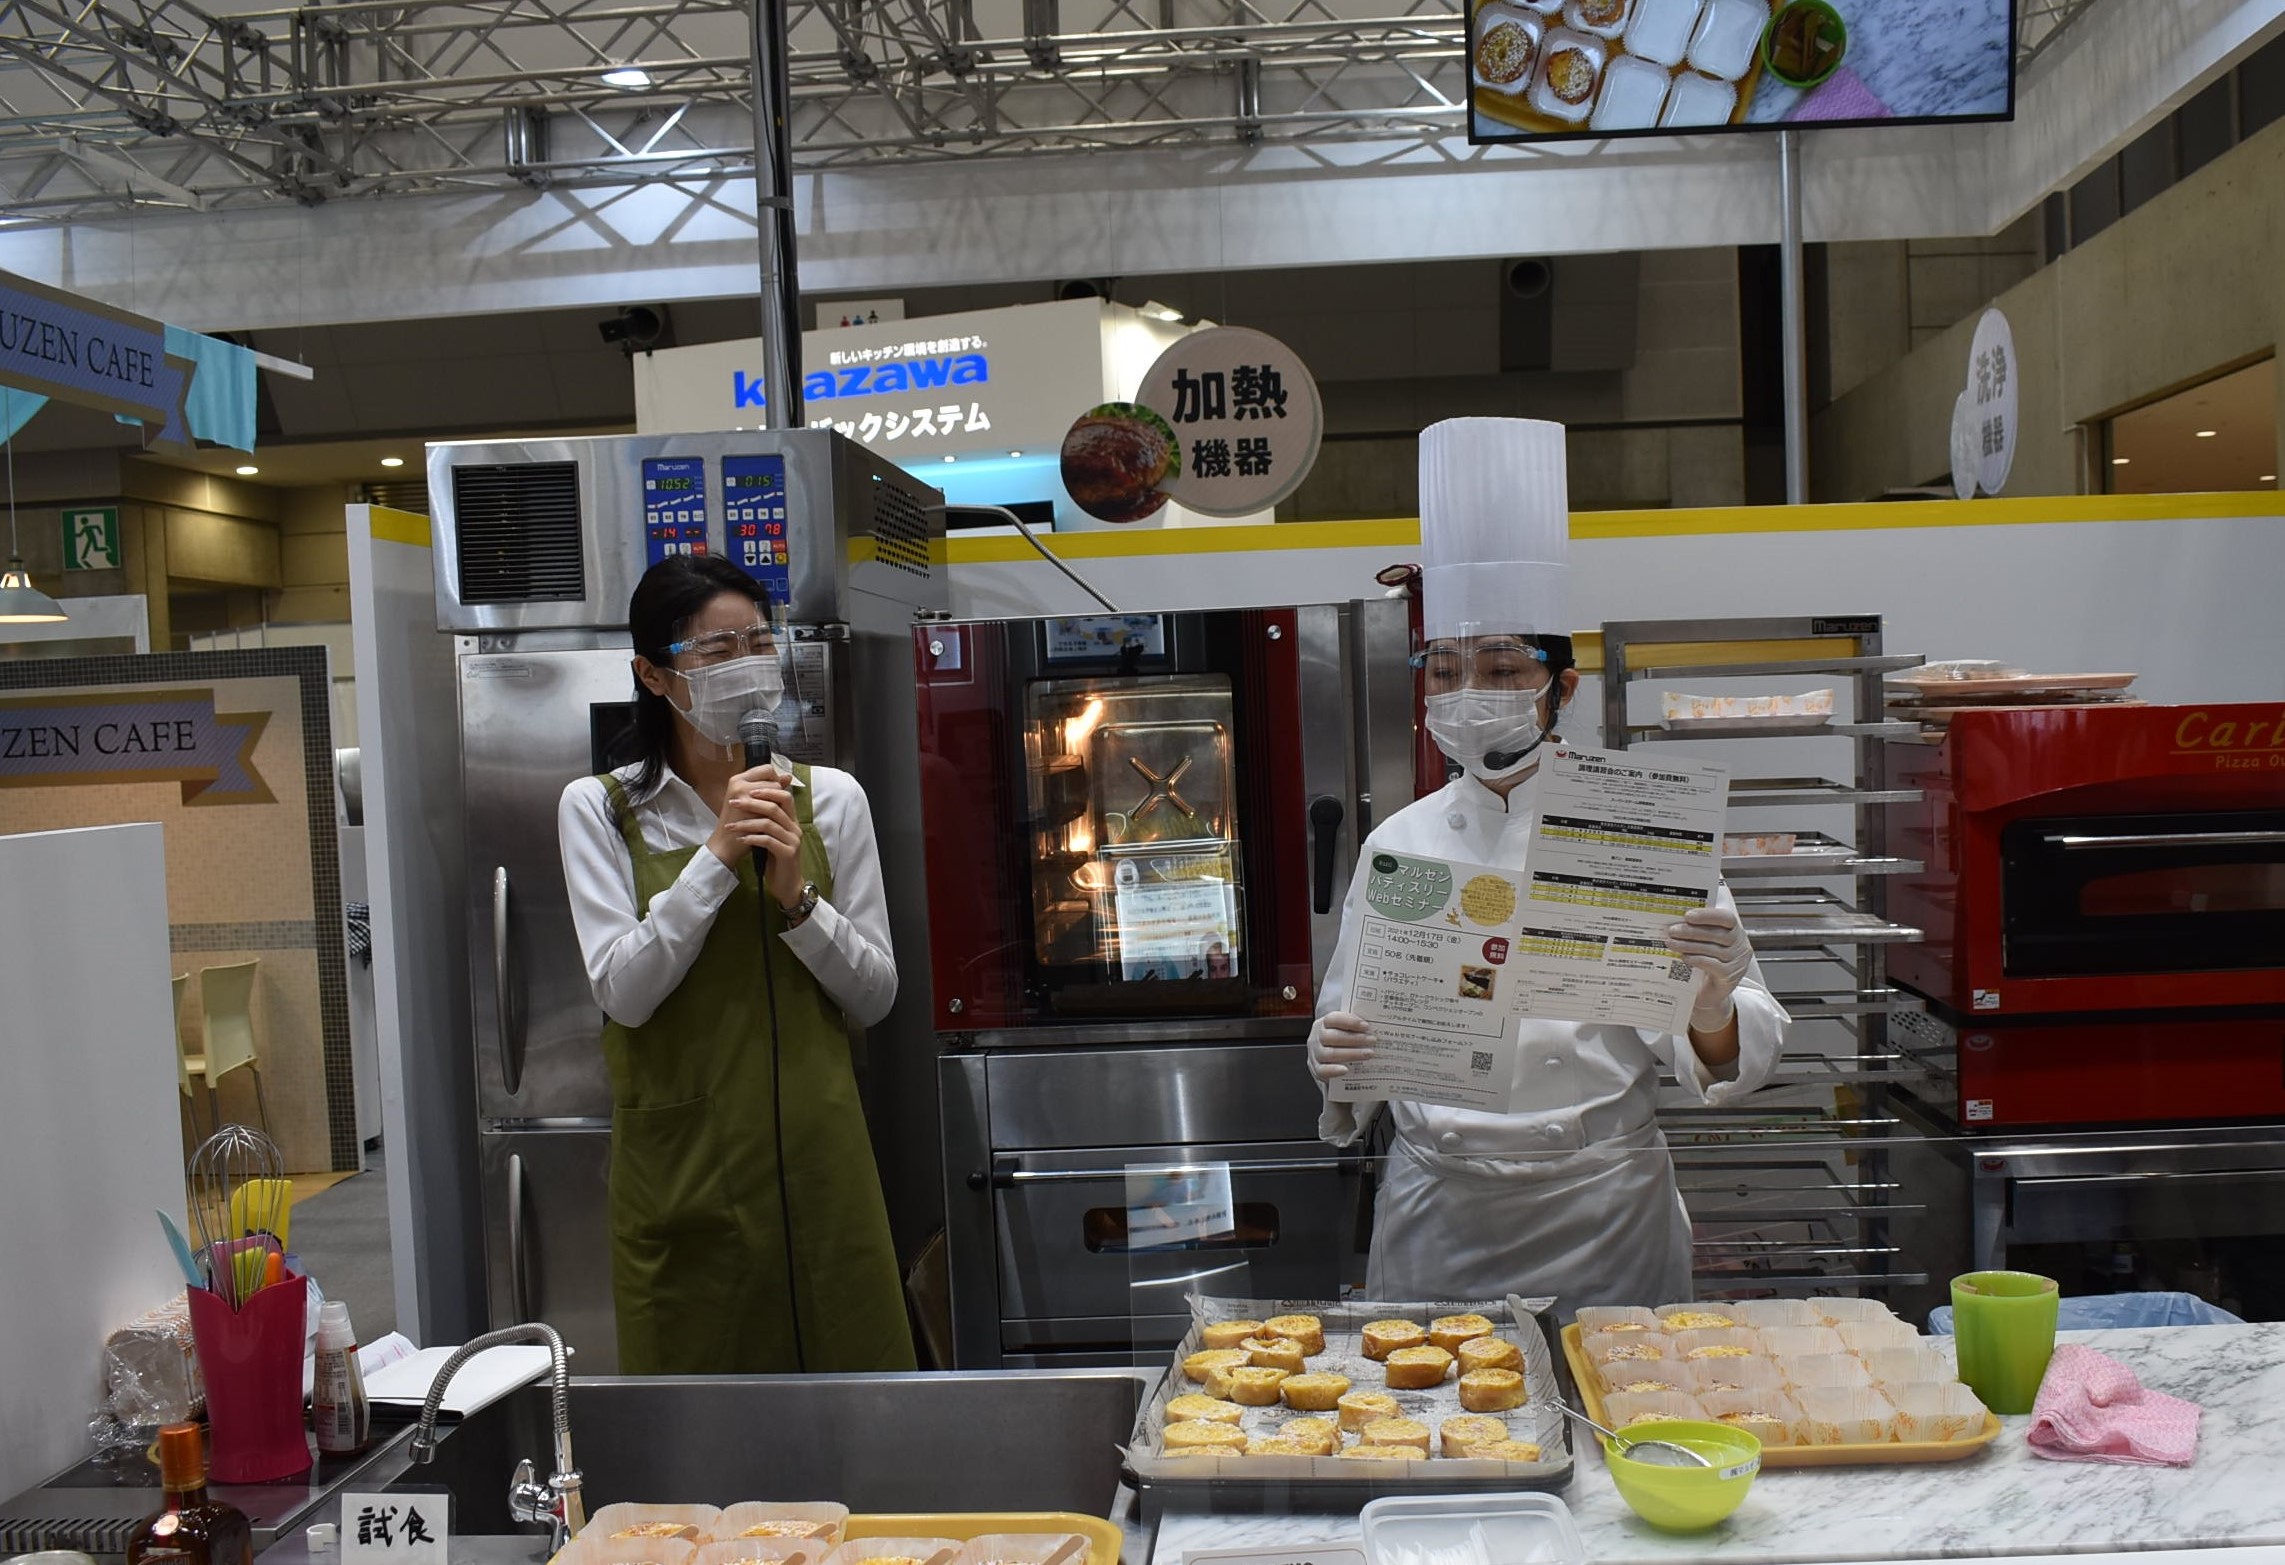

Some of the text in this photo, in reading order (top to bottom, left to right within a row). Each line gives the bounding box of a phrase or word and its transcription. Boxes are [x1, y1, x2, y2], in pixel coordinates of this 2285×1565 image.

[87, 337, 154, 388] CAFE
[829, 335, 989, 366] 新しいキッチン環境を創造する。
[733, 353, 989, 409] kazawa
[1172, 364, 1288, 424] 加熱
[657, 463, 690, 471] Maruzen
[1192, 438, 1273, 478] 機器
[740, 523, 782, 536] 30 78
[1813, 619, 1878, 633] Maruzen
[2, 720, 197, 758] ZEN CAFE
[1568, 751, 1606, 763] Maruzen
[2215, 754, 2261, 769] Pizza
[1367, 888, 1444, 911] Webセミナー
[357, 1505, 436, 1548] 試食
